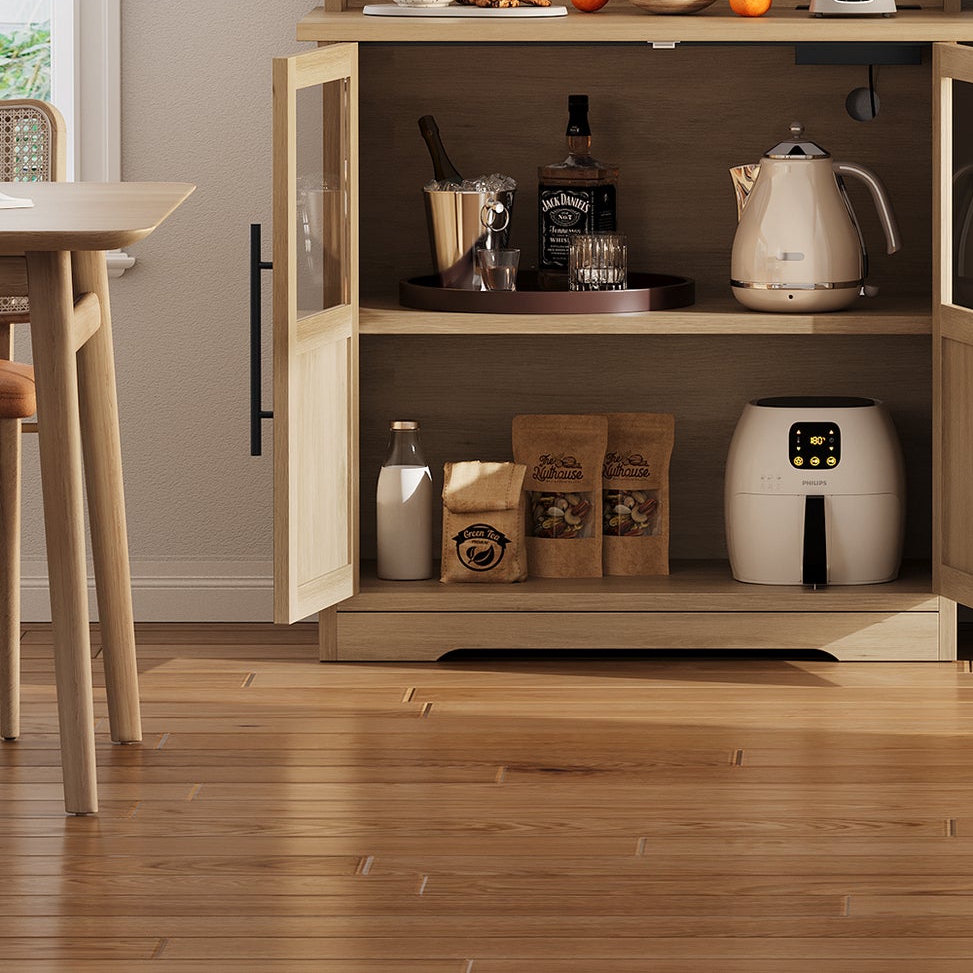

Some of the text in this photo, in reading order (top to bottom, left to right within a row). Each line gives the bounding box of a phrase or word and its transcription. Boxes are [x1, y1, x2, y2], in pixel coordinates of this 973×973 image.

[542, 193, 591, 213] JACK DANIEL'S
[532, 464, 583, 482] Nuthouse
[463, 529, 500, 540] Green Tea
